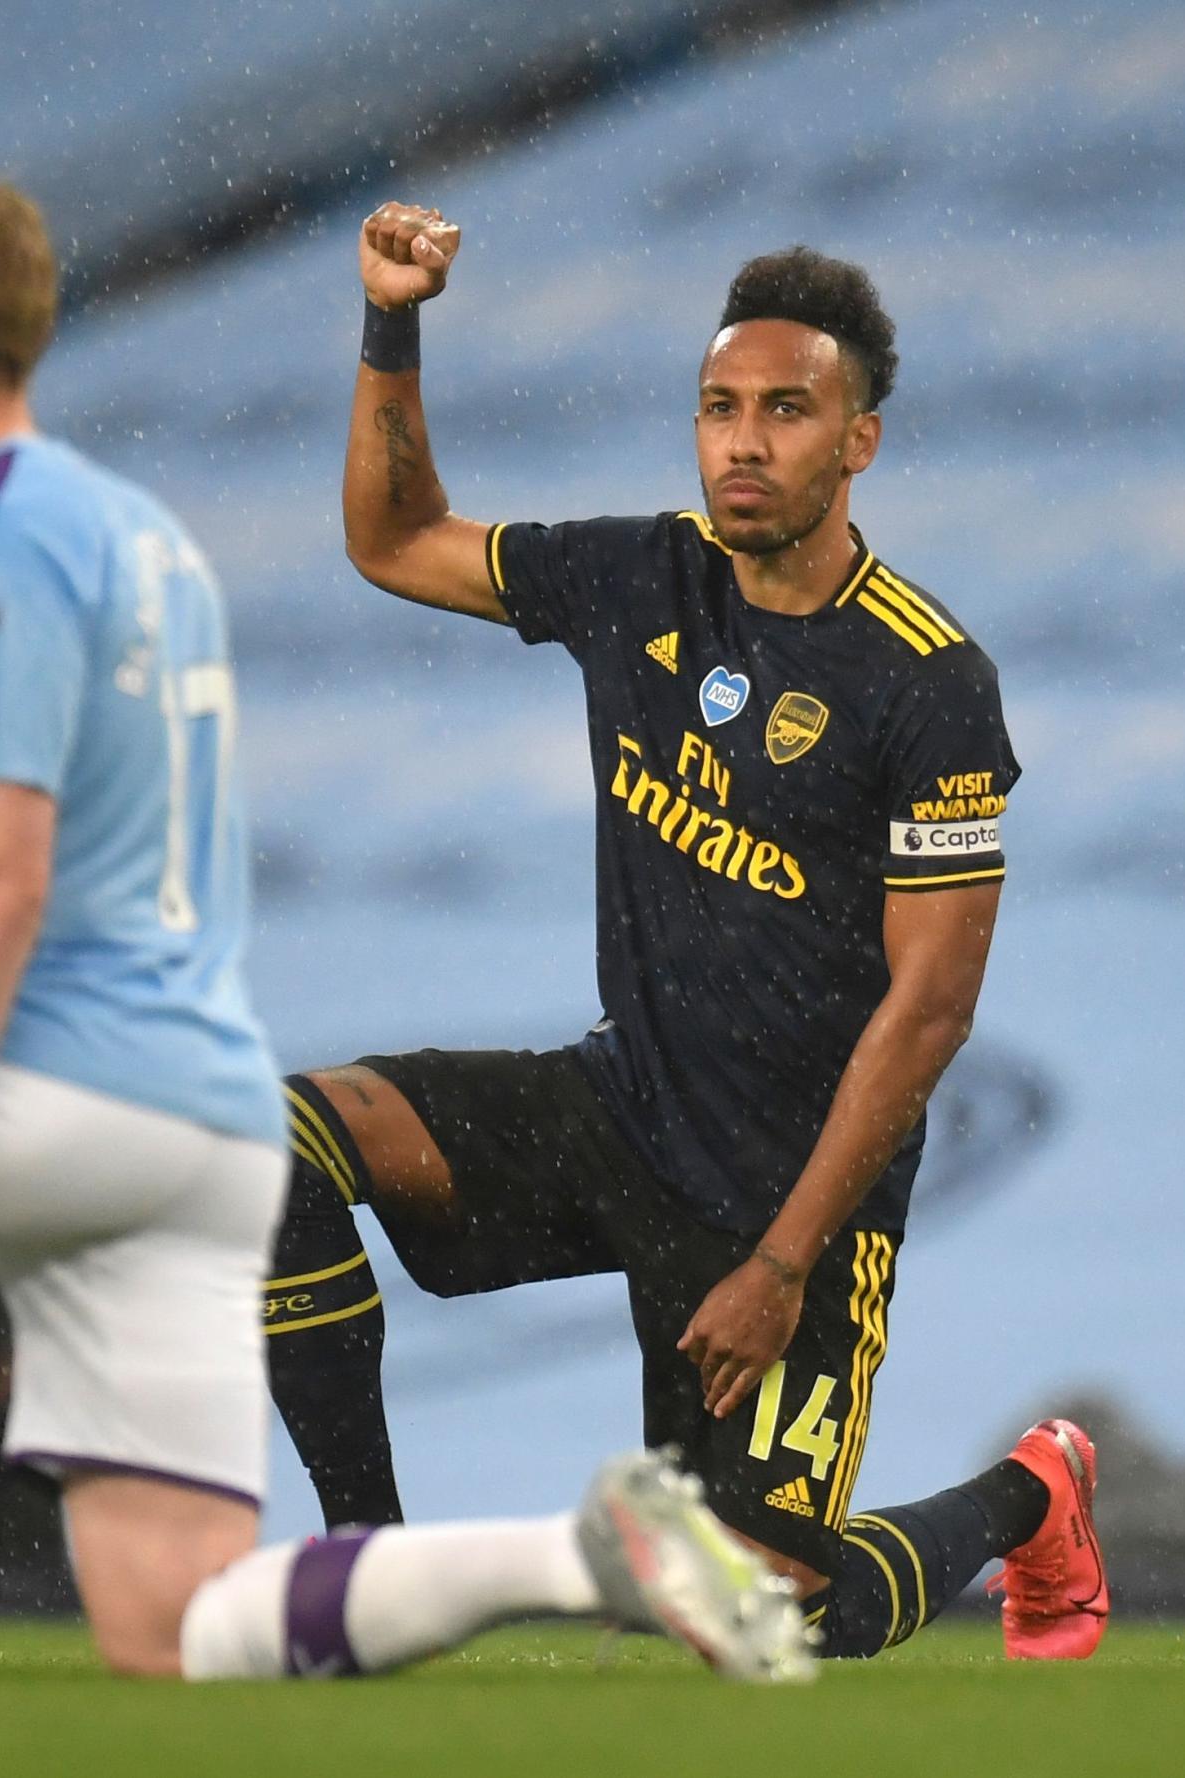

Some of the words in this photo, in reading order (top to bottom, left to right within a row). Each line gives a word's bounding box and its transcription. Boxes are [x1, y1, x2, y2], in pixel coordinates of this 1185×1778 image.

[645, 643, 677, 675] adidas
[709, 686, 738, 707] NHS
[677, 731, 730, 808] Fly
[936, 771, 993, 798] VISIT
[611, 733, 806, 899] Emirates
[929, 823, 999, 851] Capta
[262, 1293, 315, 1317] FC
[747, 1360, 840, 1482] 14
[765, 1493, 815, 1518] adidas
